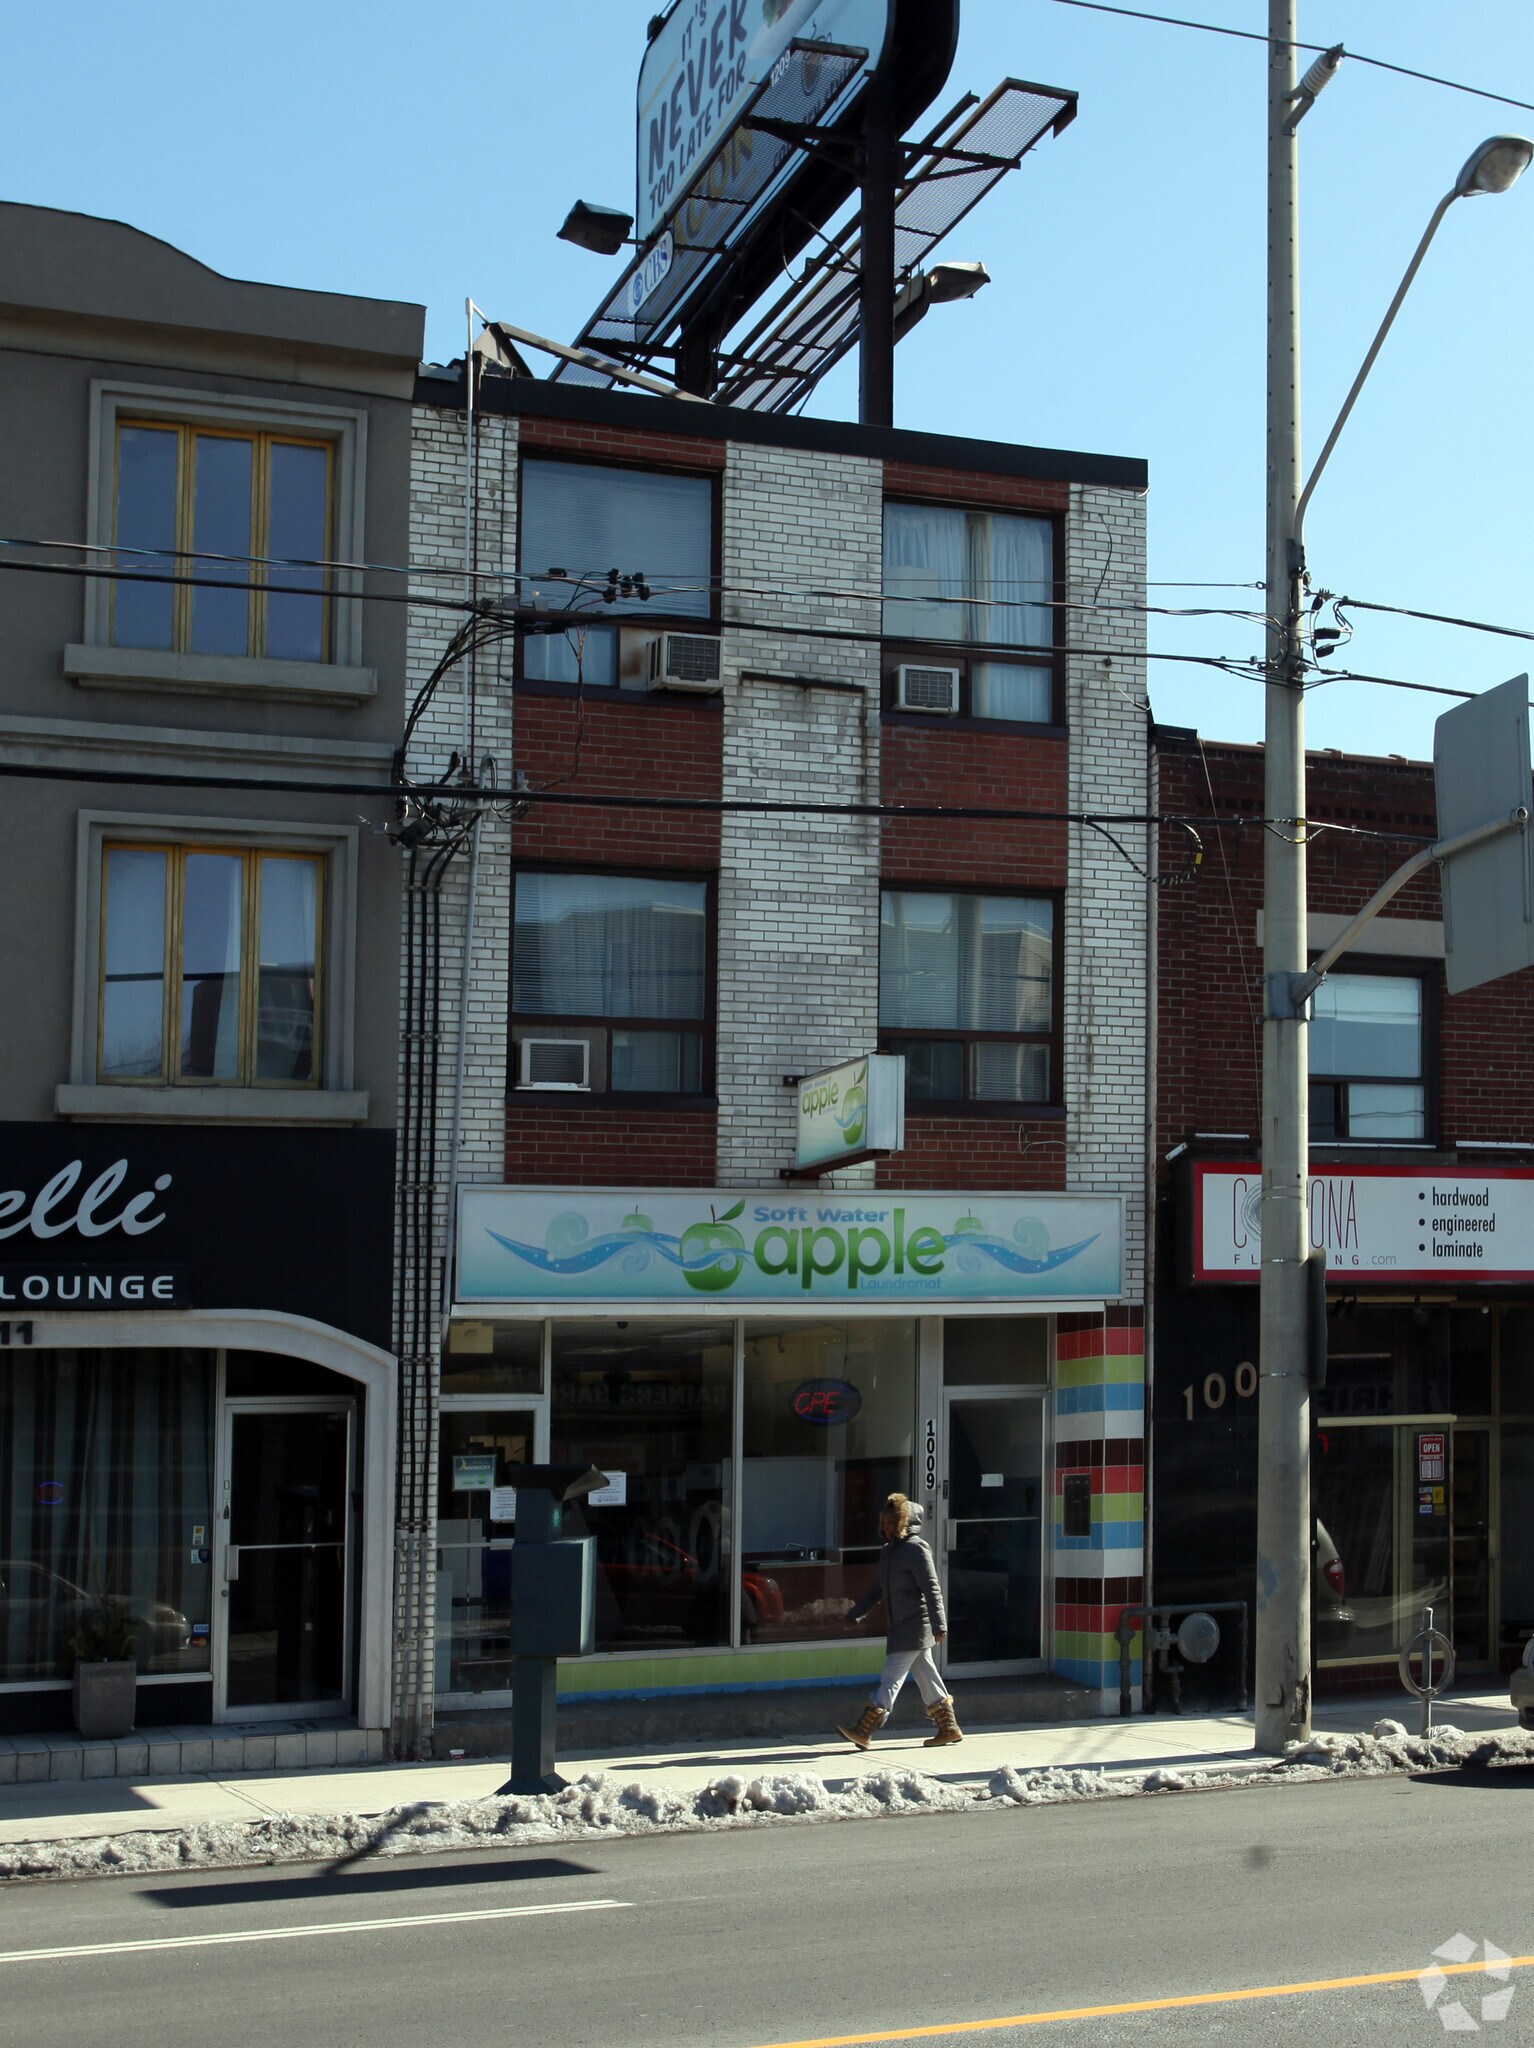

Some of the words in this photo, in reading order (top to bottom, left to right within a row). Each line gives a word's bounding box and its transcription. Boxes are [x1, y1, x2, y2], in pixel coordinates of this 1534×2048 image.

[681, 0, 707, 61] IT'S
[770, 49, 791, 88] 1209
[648, 0, 748, 185] NEVER
[650, 160, 675, 219] TOO
[679, 98, 714, 172] LATE
[717, 50, 747, 119] FOR
[644, 239, 668, 292] CBS
[802, 1076, 839, 1118] apple
[754, 1206, 808, 1223] Soft
[816, 1208, 890, 1223] Water
[1233, 1177, 1359, 1250] CONA
[1432, 1187, 1489, 1207] hardwood
[1432, 1213, 1496, 1236] engineered
[753, 1207, 947, 1290] apple
[1432, 1237, 1484, 1258] laminate
[0, 1275, 174, 1301] LOUNGE
[860, 1276, 942, 1291] Laundromat
[1183, 1361, 1258, 1421] 100
[925, 1419, 936, 1490] 1009
[1423, 1443, 1441, 1453] OPEN
